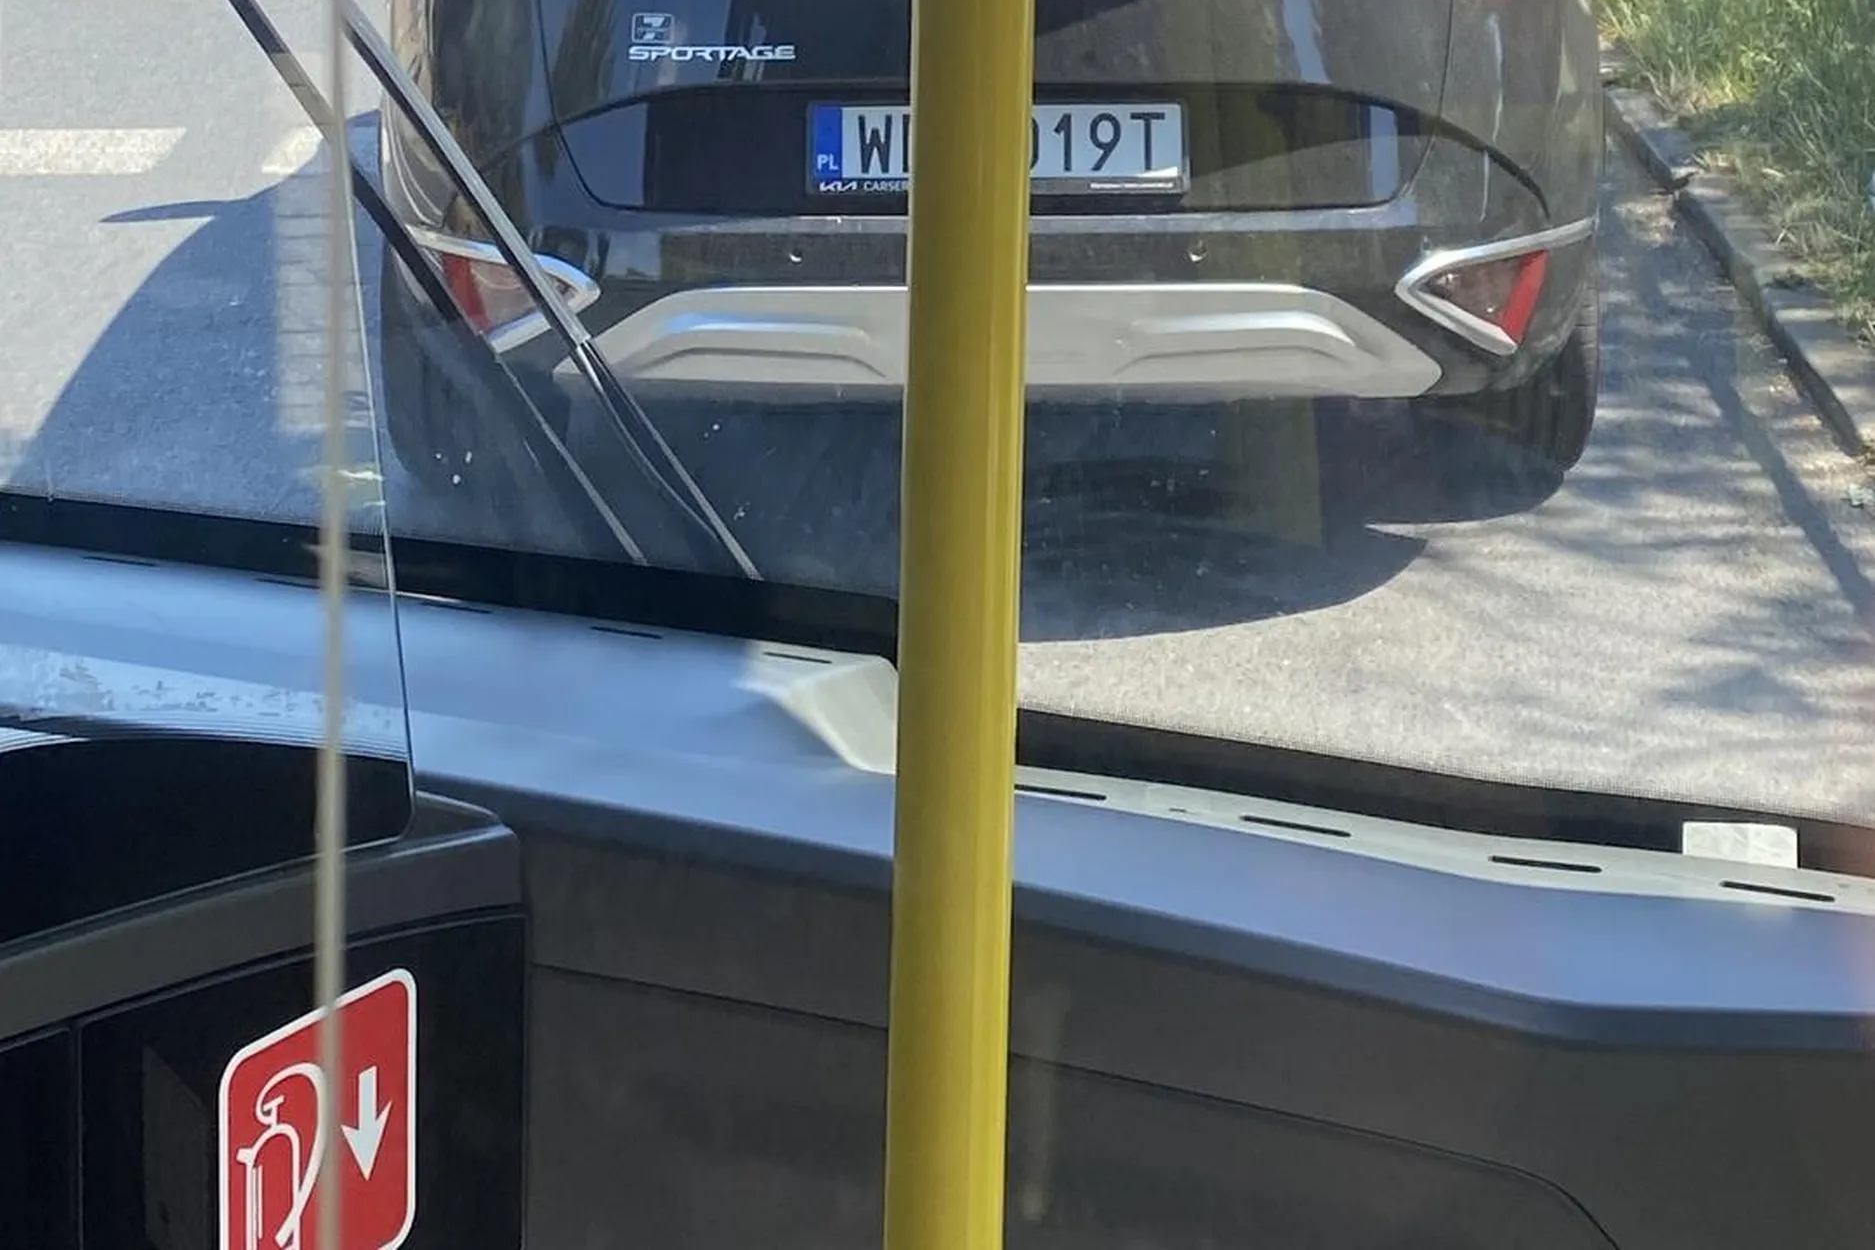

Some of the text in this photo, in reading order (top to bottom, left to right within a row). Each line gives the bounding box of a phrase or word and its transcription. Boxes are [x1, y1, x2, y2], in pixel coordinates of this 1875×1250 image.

[628, 45, 796, 61] SPORTAGE
[858, 112, 1166, 174] W 19T
[817, 153, 839, 171] PL
